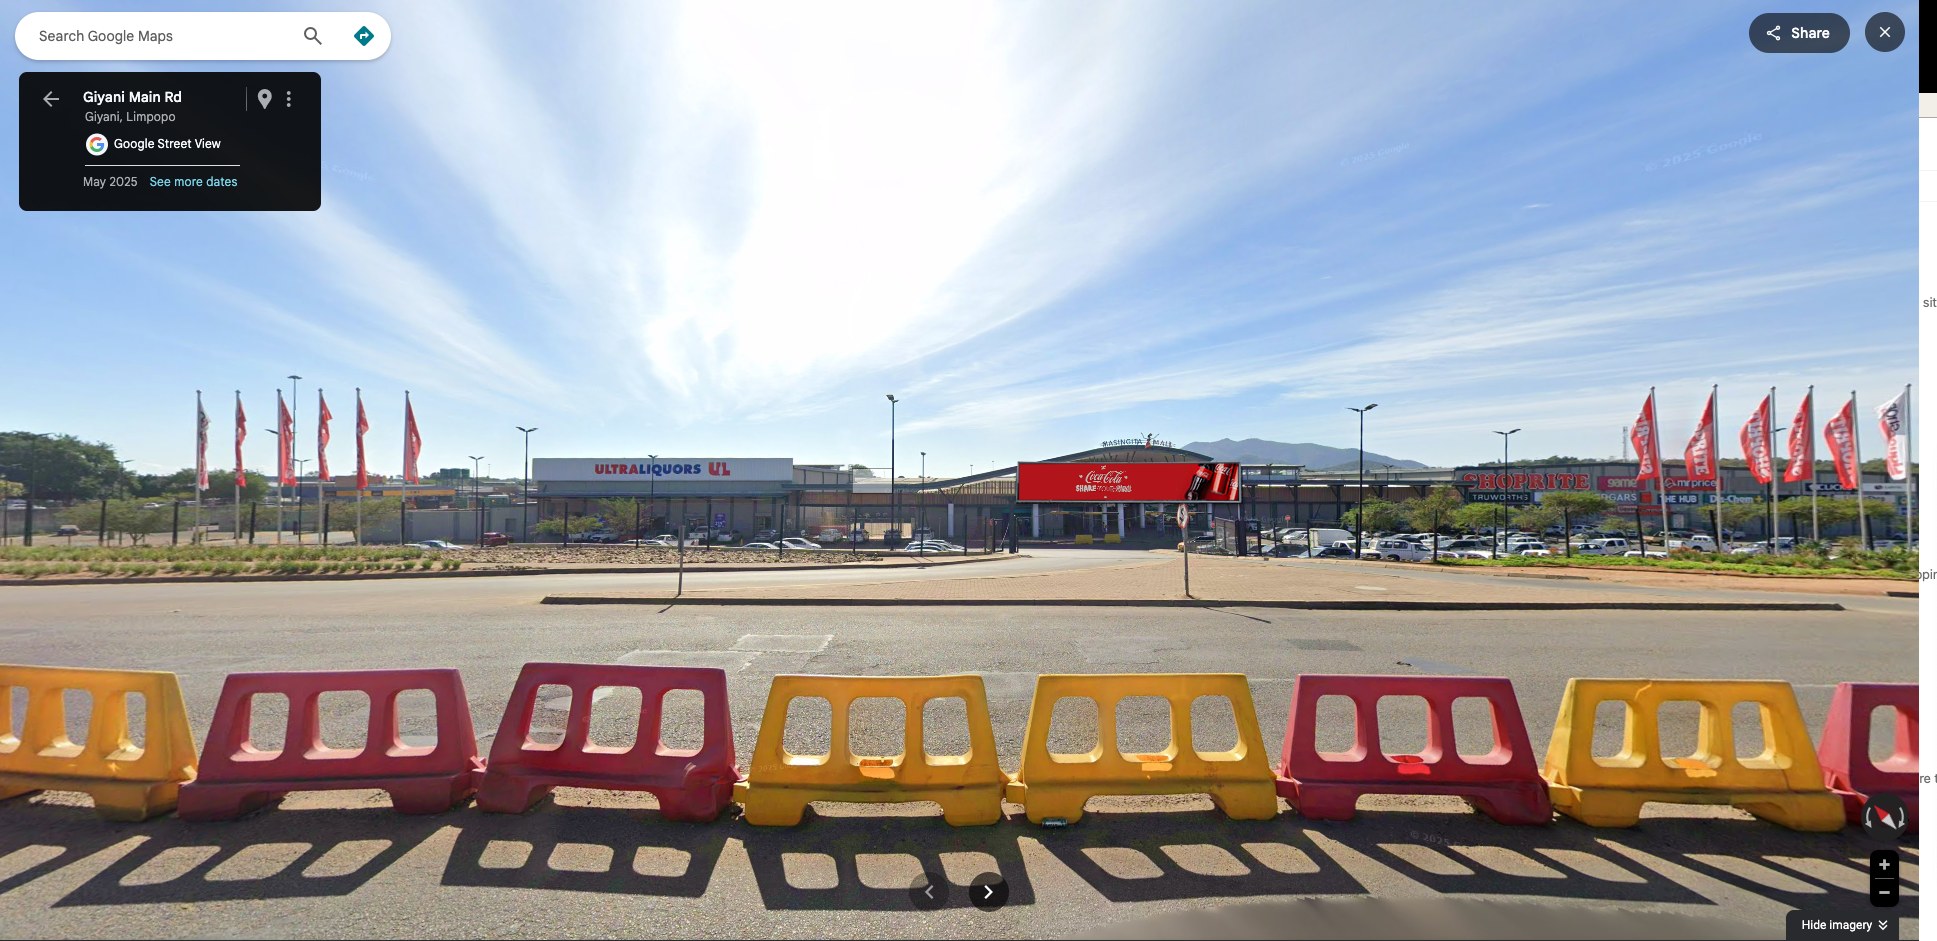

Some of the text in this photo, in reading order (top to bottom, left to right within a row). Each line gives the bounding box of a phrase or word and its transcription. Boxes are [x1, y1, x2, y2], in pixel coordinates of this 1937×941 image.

[594, 461, 731, 477] ULTRALIQUORS UL
[1463, 473, 1590, 490] SHOPRITE
[1607, 479, 1638, 488] game
[1679, 495, 1698, 503] HUB
